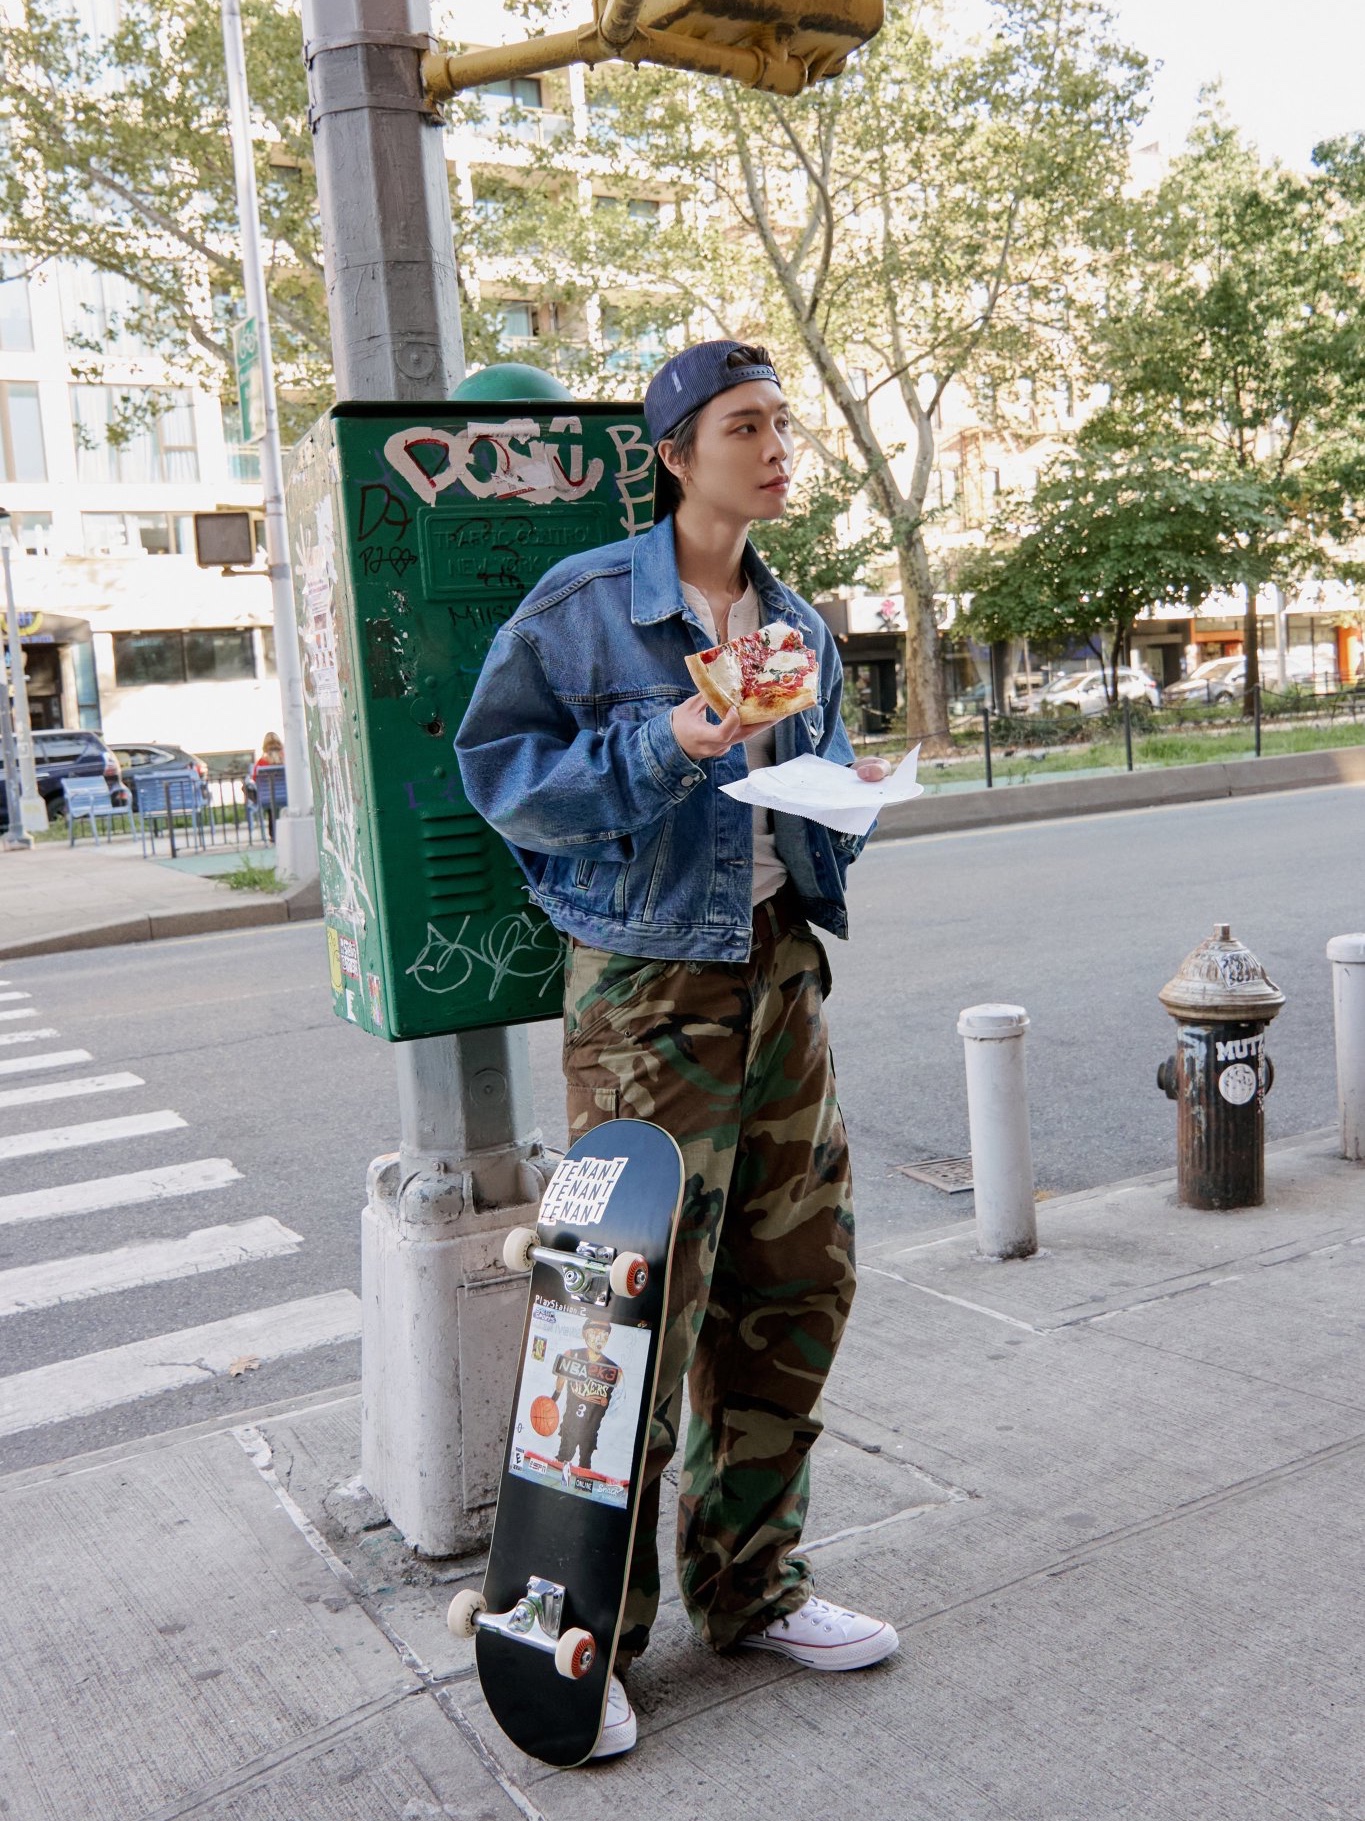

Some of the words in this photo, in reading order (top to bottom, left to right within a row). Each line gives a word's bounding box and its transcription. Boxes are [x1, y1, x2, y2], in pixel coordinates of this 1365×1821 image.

[447, 557, 488, 576] NEW
[558, 1161, 624, 1182] TENANT
[548, 1180, 614, 1202] TENANT
[541, 1201, 605, 1223] TENANT
[535, 1294, 578, 1314] PlayStation
[580, 1306, 587, 1316] 2
[559, 1358, 588, 1378] NBA
[588, 1364, 617, 1381] 2K3
[575, 1403, 587, 1418] 3
[516, 1452, 522, 1464] E
[529, 1460, 546, 1473] ESPN
